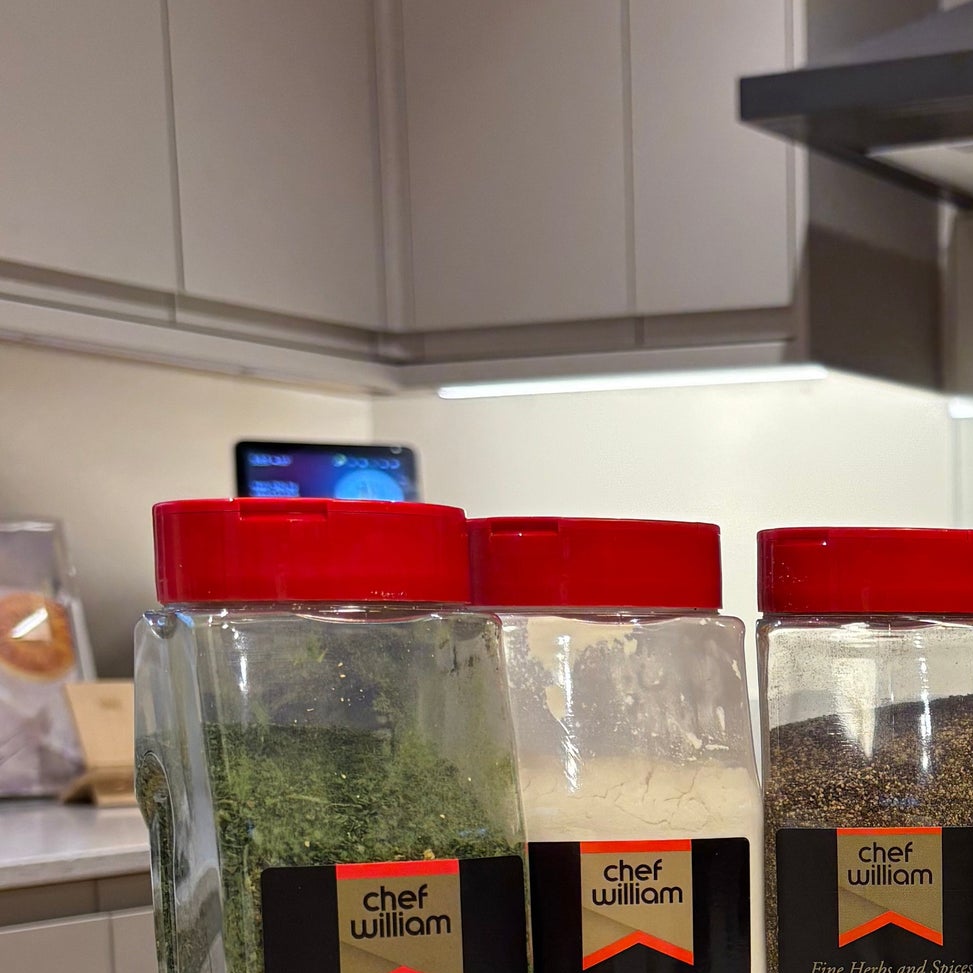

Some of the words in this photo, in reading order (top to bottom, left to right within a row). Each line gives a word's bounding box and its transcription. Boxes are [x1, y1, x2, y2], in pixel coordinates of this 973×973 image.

[859, 842, 913, 863] chef
[604, 859, 662, 881] chef
[848, 865, 933, 885] william
[363, 884, 428, 911] chef
[592, 883, 683, 906] william
[351, 913, 451, 939] william
